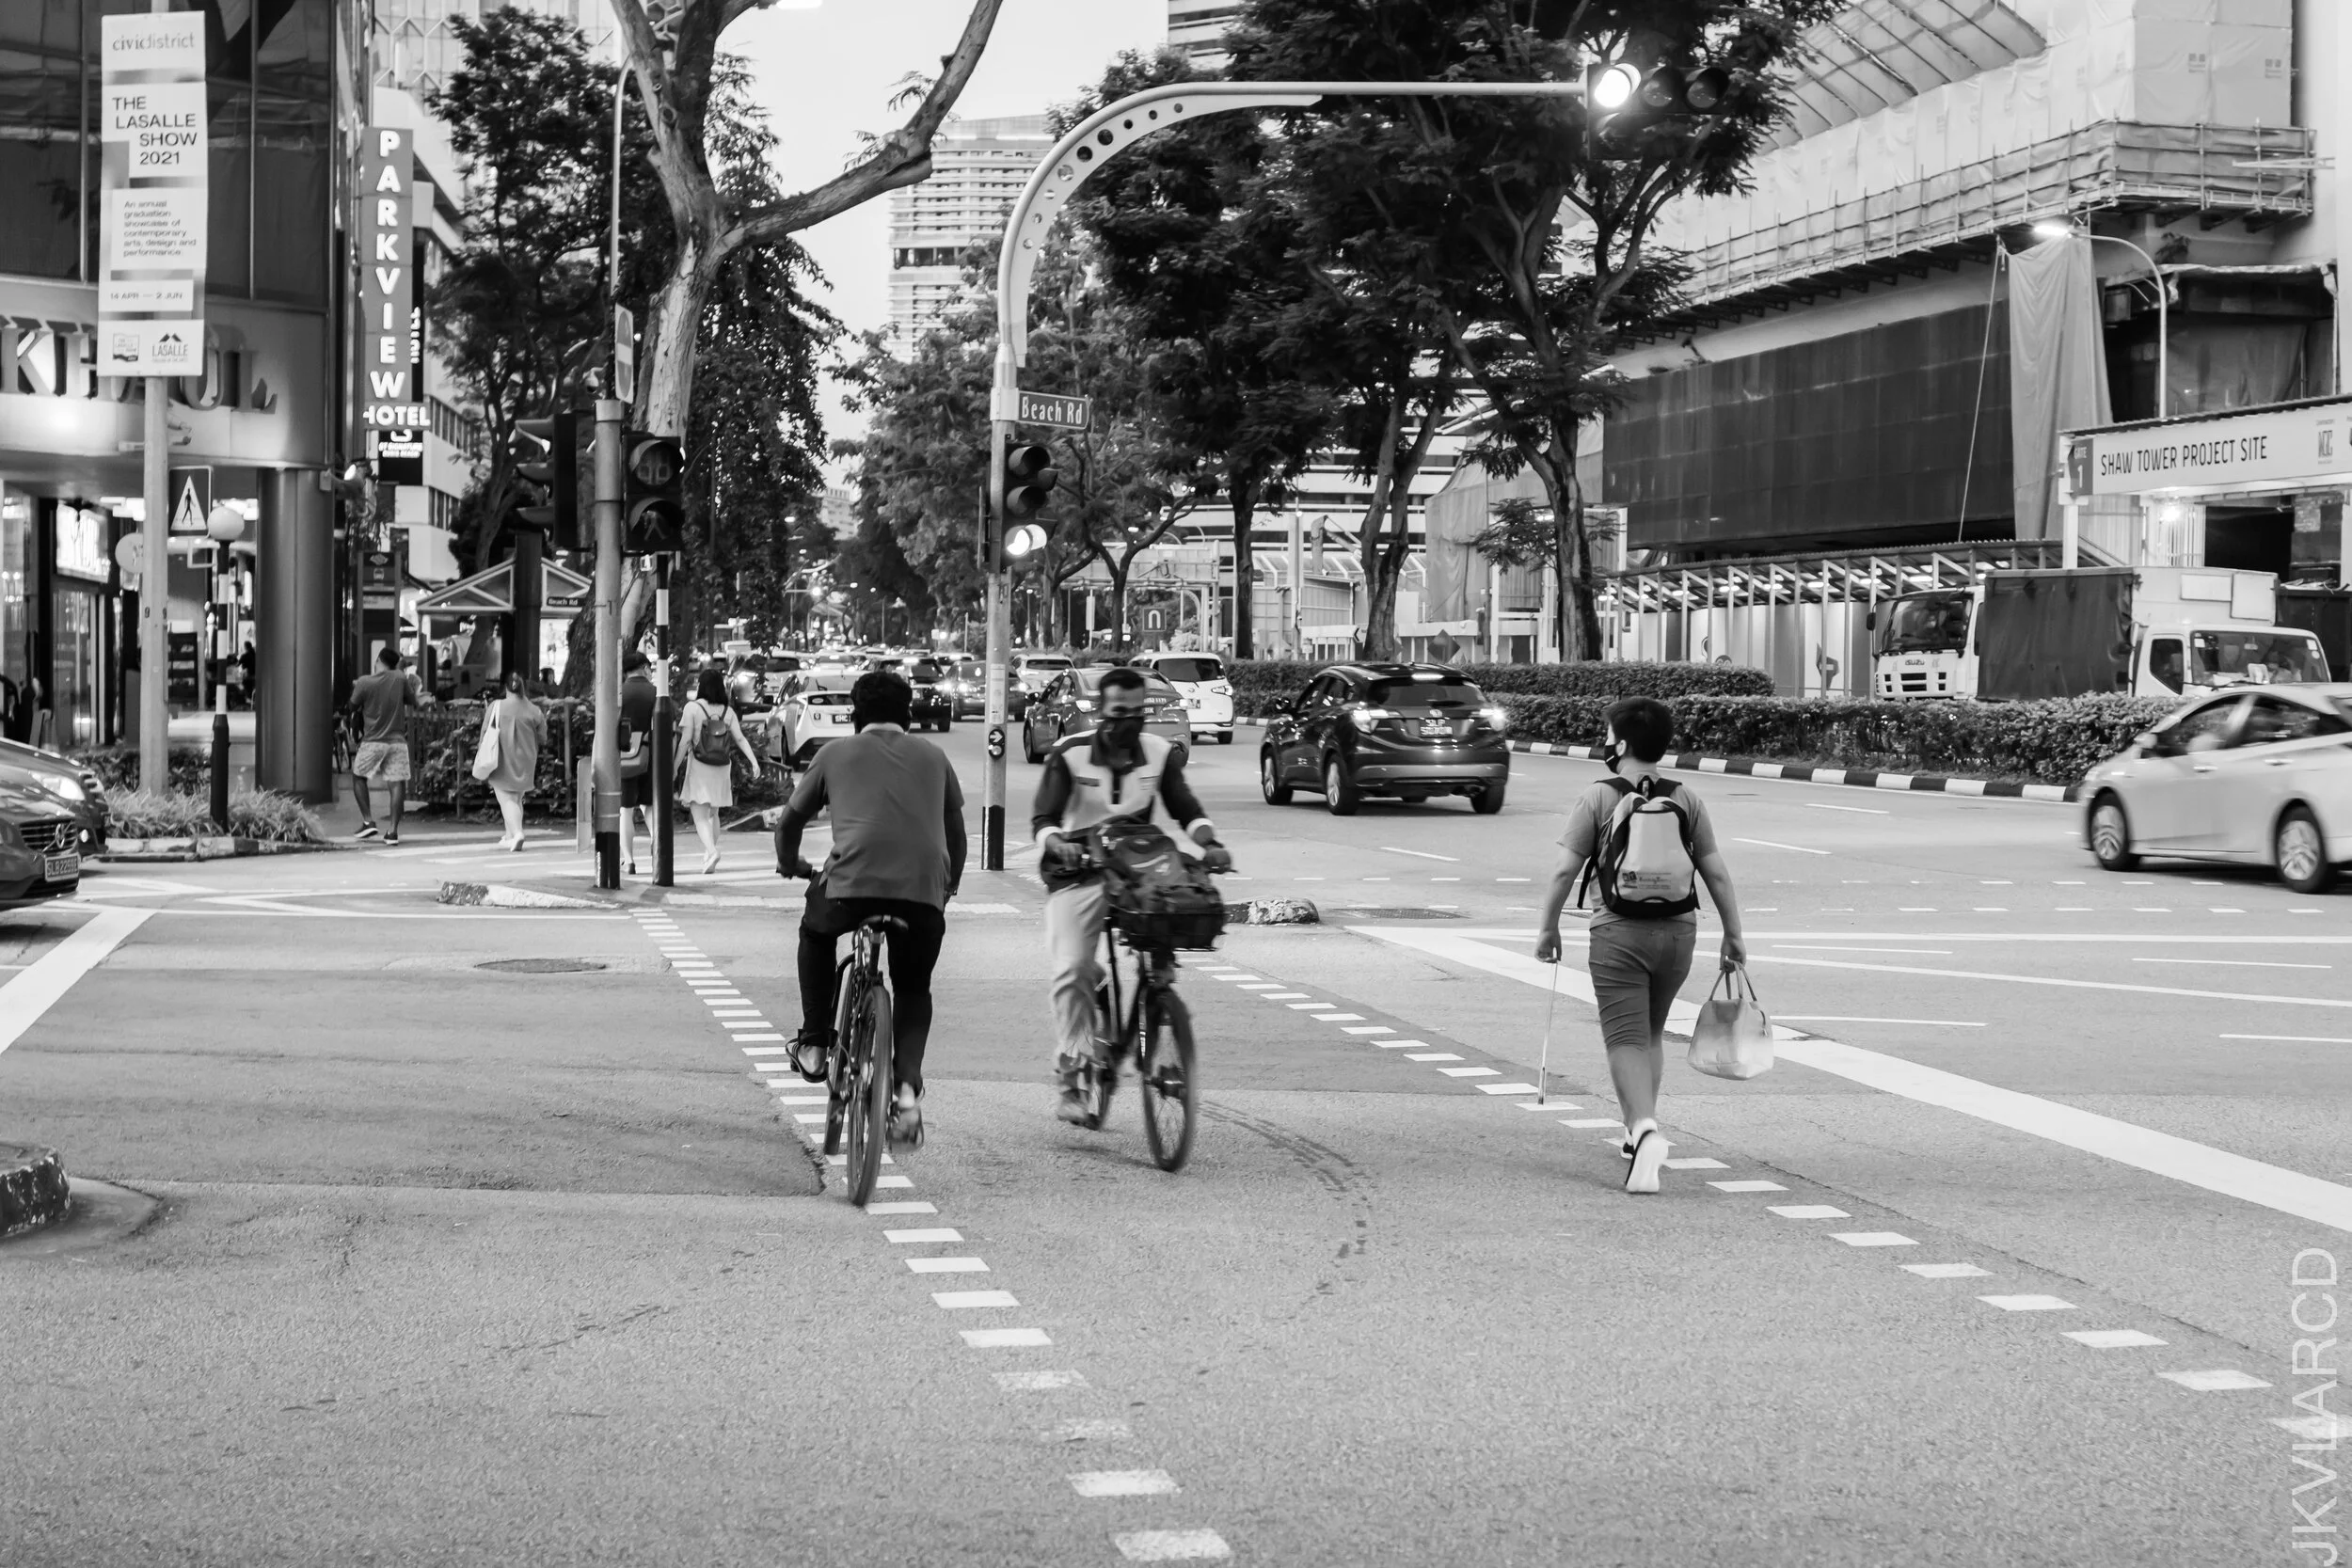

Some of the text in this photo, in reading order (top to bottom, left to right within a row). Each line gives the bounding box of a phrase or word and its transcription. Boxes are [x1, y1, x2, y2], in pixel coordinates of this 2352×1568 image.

[113, 96, 147, 111] THE
[116, 114, 197, 130] LASALLE
[139, 133, 198, 147] SHOW
[139, 151, 181, 166] 2021
[370, 130, 405, 399] PARKVIEW
[151, 344, 189, 356] LASALLE
[1021, 396, 1083, 424] Beach Rd
[2101, 436, 2268, 476] SHAW TOWER PROJECT SITE
[2077, 464, 2083, 489] 1
